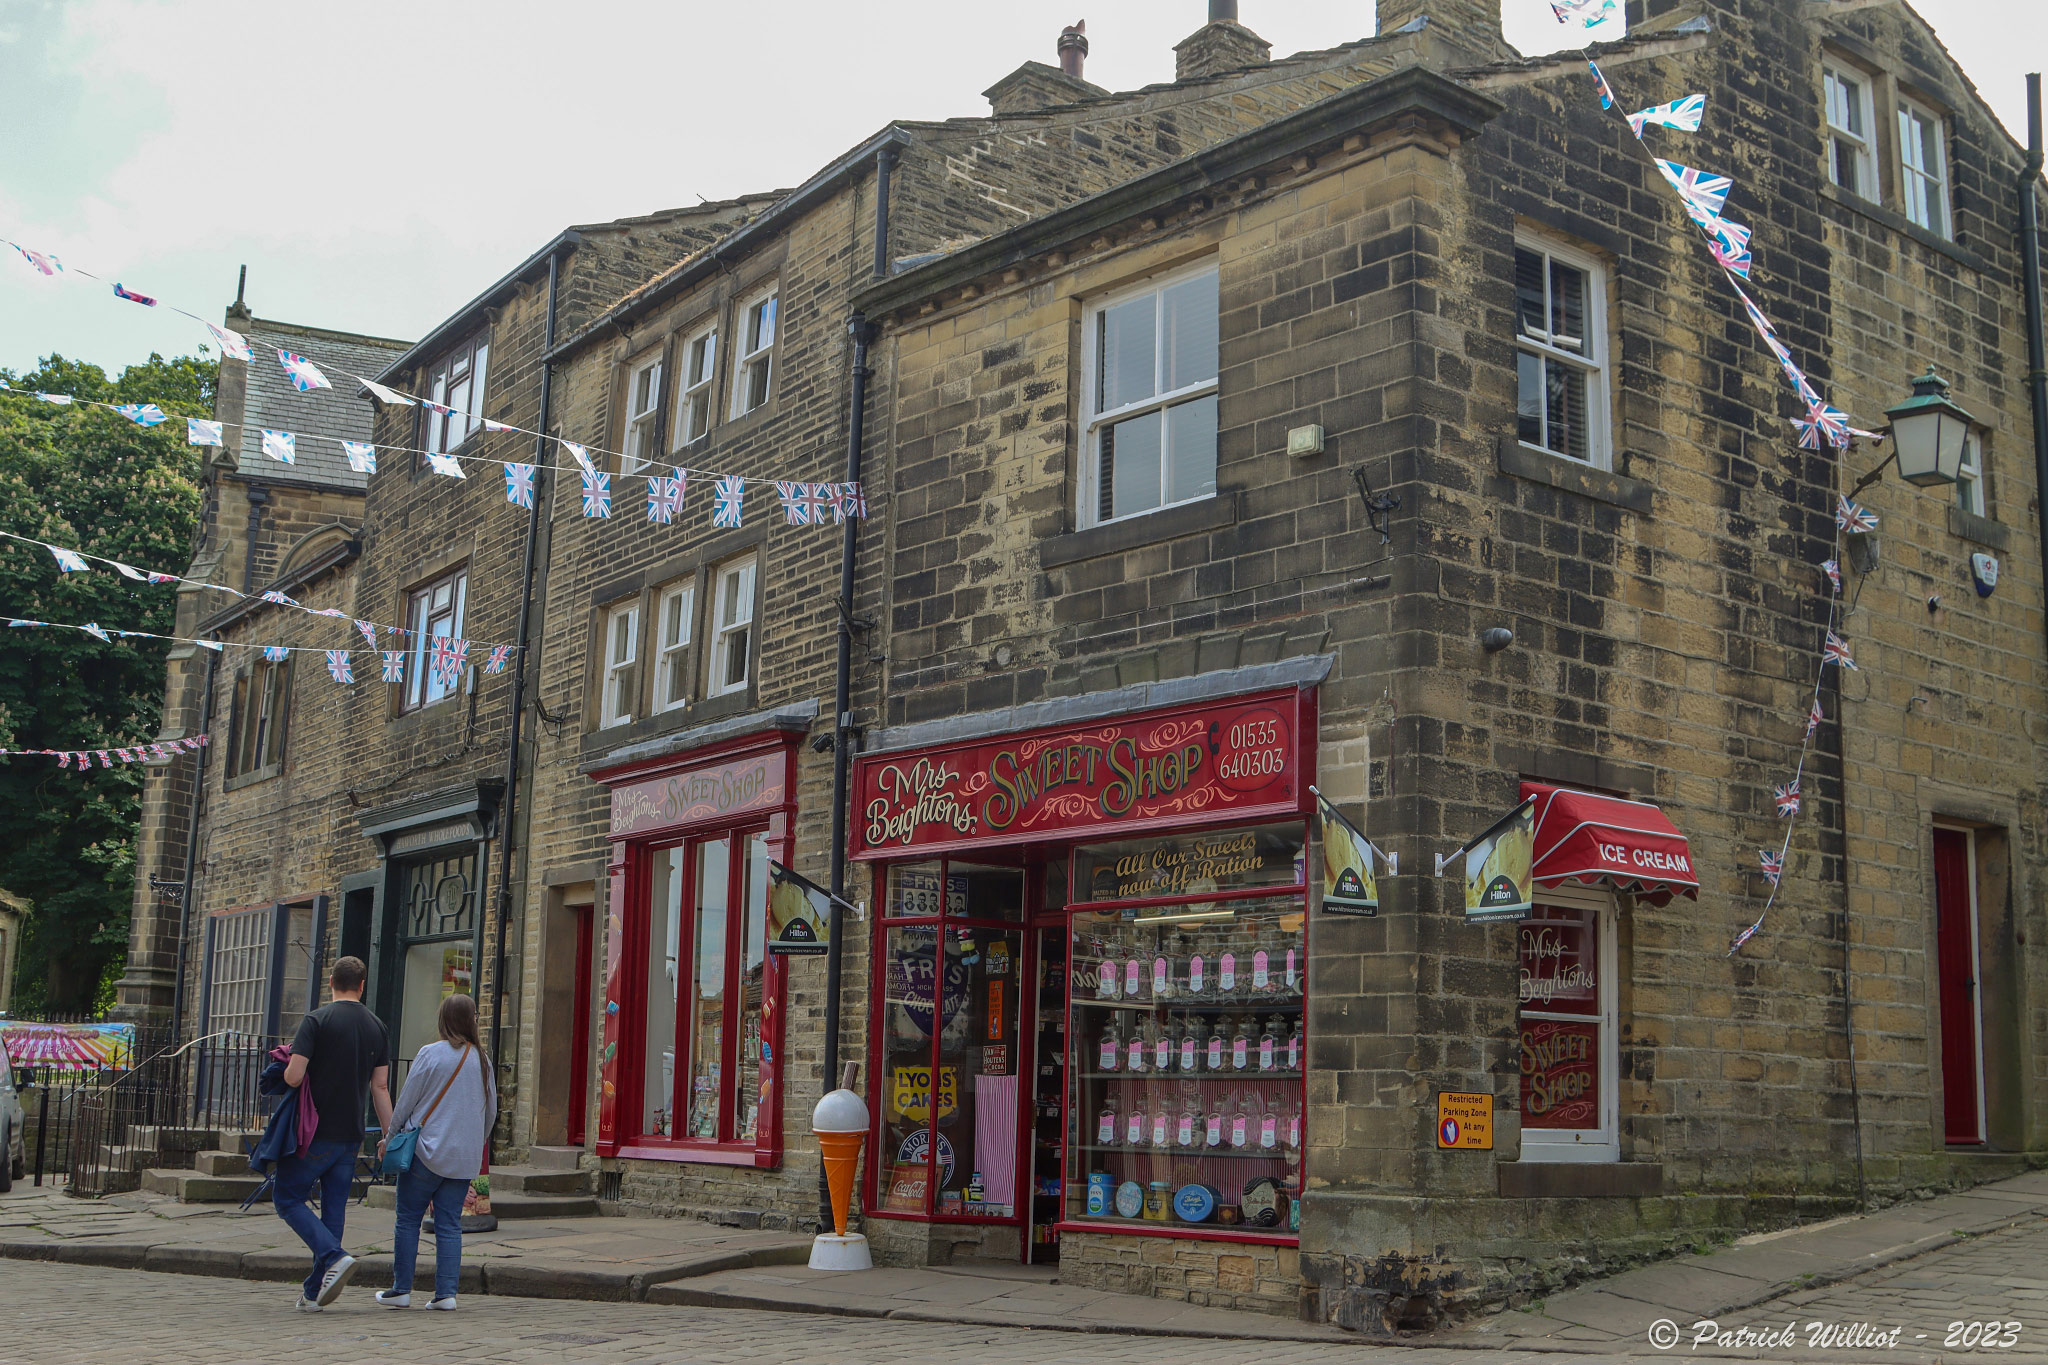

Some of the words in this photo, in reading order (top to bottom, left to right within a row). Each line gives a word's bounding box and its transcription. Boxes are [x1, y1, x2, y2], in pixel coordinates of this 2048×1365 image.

[1231, 719, 1276, 749] 01535
[1219, 748, 1284, 781] 640303
[878, 758, 959, 802] Mrs
[614, 787, 642, 810] Mrs
[865, 791, 978, 847] Beightons
[1115, 852, 1147, 878] All
[1151, 848, 1188, 870] Our
[1193, 834, 1257, 862] Sweets
[1599, 843, 1628, 864] ICE
[1632, 849, 1690, 873] CREAM
[915, 874, 955, 892] FRYS
[1118, 876, 1156, 898] now
[1160, 866, 1191, 894] off
[1196, 854, 1265, 882] Ration
[1342, 882, 1359, 893] Hilton
[1490, 890, 1511, 901] Hilton
[789, 929, 808, 937] Hilton
[1522, 927, 1569, 961] Mrs
[1519, 963, 1596, 1005] Beightons
[904, 990, 960, 1015] CHOCLATE
[1448, 1094, 1483, 1104] Restricted
[1443, 1107, 1469, 1117] Parking
[1471, 1108, 1487, 1117] Zone
[1463, 1122, 1472, 1130] At
[1473, 1124, 1485, 1132] any
[905, 1133, 946, 1155] MORS
[1467, 1136, 1482, 1144] time
